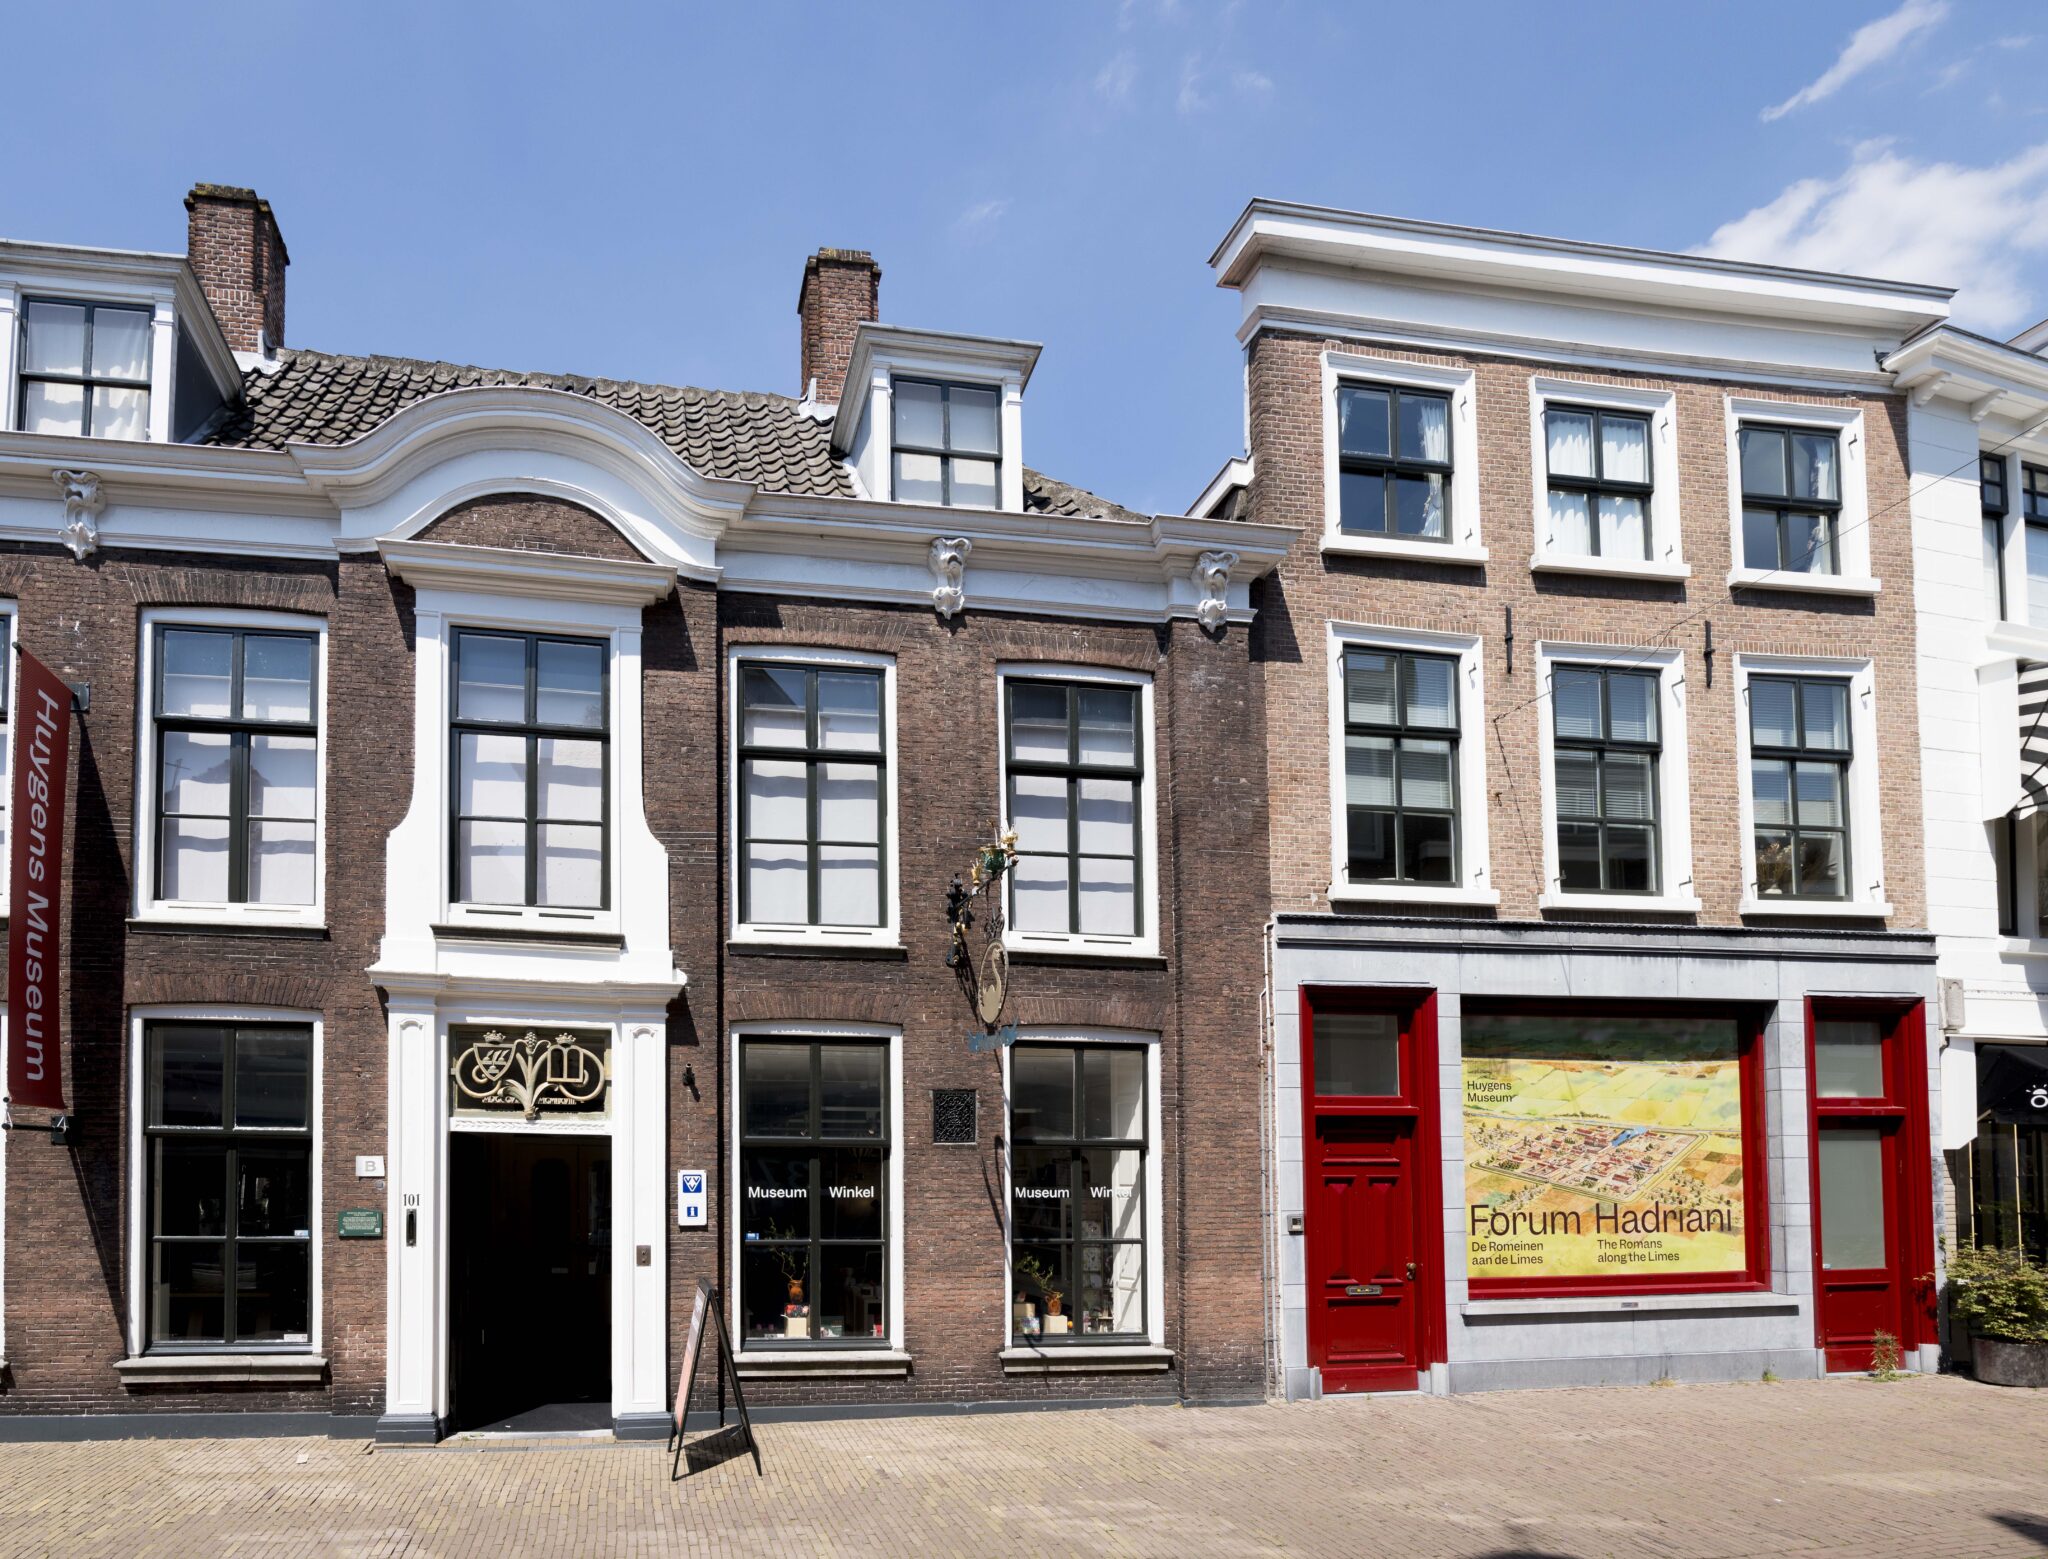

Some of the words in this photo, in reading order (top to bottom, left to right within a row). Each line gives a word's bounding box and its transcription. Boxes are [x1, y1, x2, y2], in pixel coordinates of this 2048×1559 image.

[28, 688, 59, 883] Huygens
[25, 889, 49, 1082] Museum
[1467, 1080, 1512, 1092] Huygens
[1467, 1092, 1513, 1102] Museum
[365, 1160, 377, 1172] B
[748, 1186, 807, 1198] Museum
[829, 1185, 875, 1198] Winkel
[1015, 1186, 1070, 1199] Museum
[1090, 1186, 1133, 1199] Winkel
[403, 1193, 420, 1207] 101
[1470, 1203, 1581, 1237] Forum
[1595, 1199, 1732, 1235] Hadriani
[1471, 1241, 1488, 1252] De
[1489, 1241, 1544, 1252] Romeinen
[1597, 1239, 1618, 1250] The
[1619, 1238, 1663, 1249] Romans
[1471, 1256, 1493, 1266] aan
[1494, 1254, 1509, 1265] de
[1510, 1253, 1544, 1265] Limes
[1597, 1252, 1628, 1265] along
[1628, 1252, 1646, 1263] the
[1648, 1251, 1680, 1262] Limes
